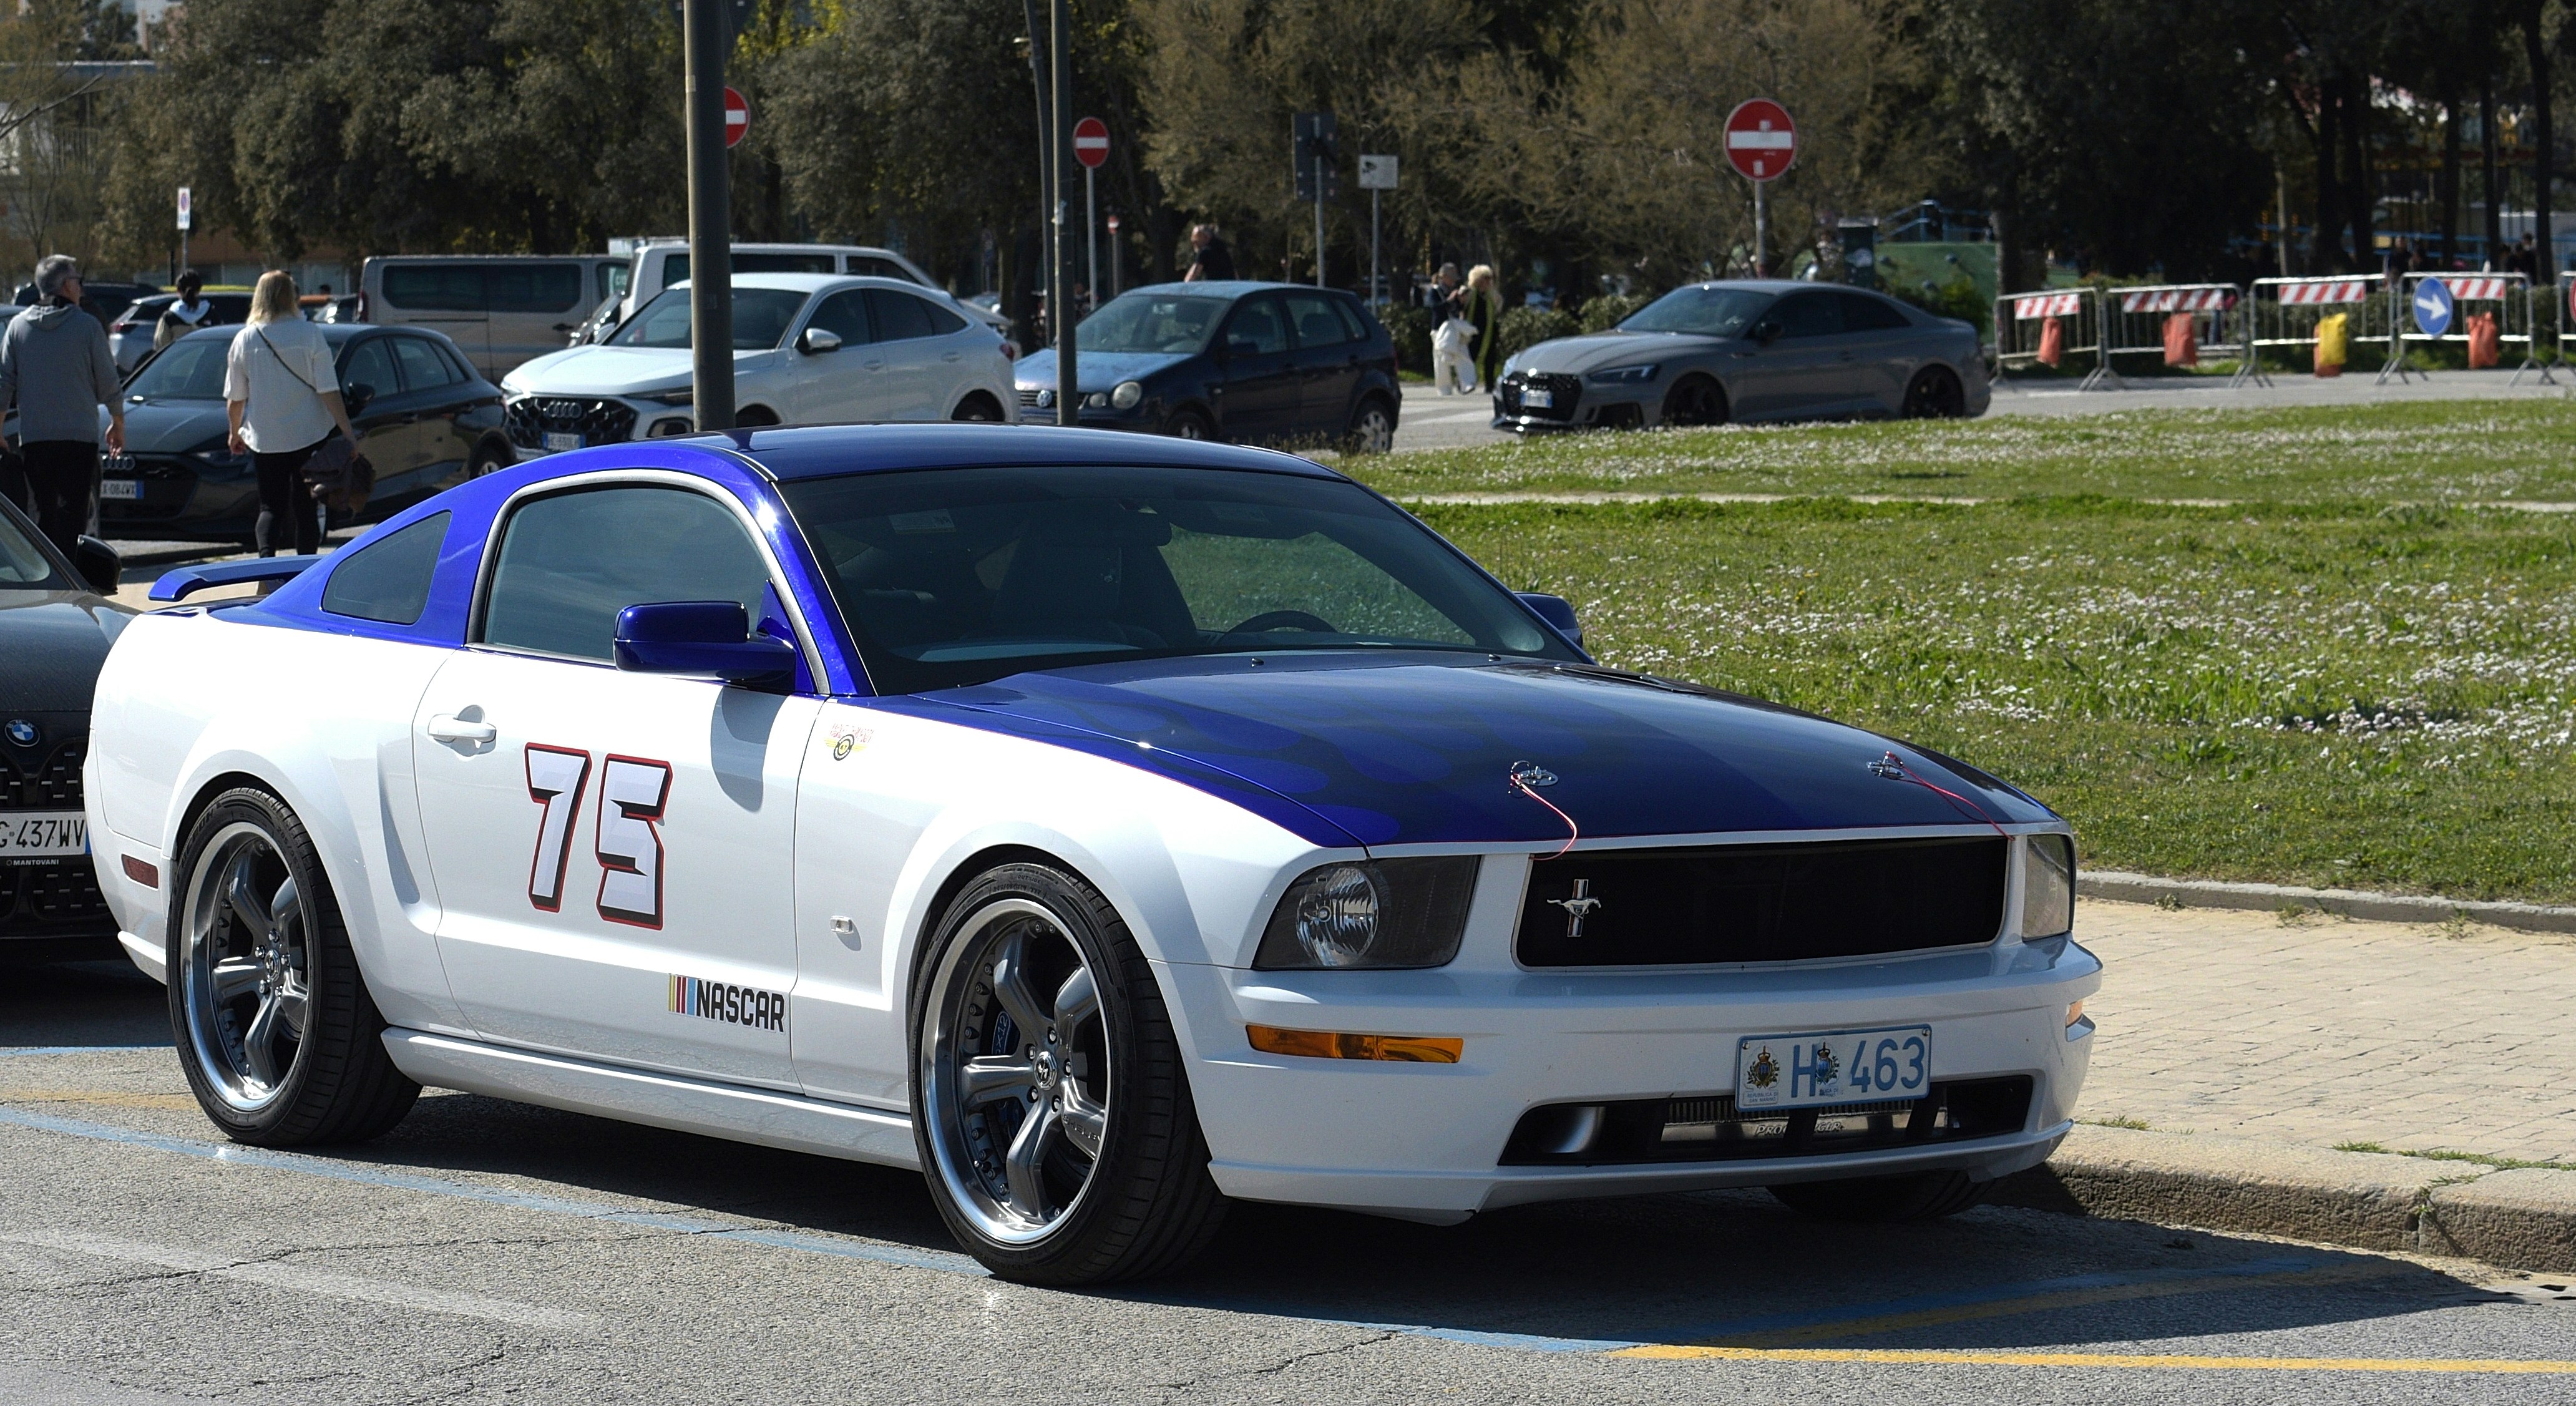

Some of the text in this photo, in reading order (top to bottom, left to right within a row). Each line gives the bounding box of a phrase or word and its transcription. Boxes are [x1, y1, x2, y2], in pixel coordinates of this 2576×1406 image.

[524, 741, 673, 930] 75
[1017, 875, 1041, 884] OUTSIDE
[696, 979, 785, 1032] NASCAR
[1850, 1036, 1925, 1093] 463
